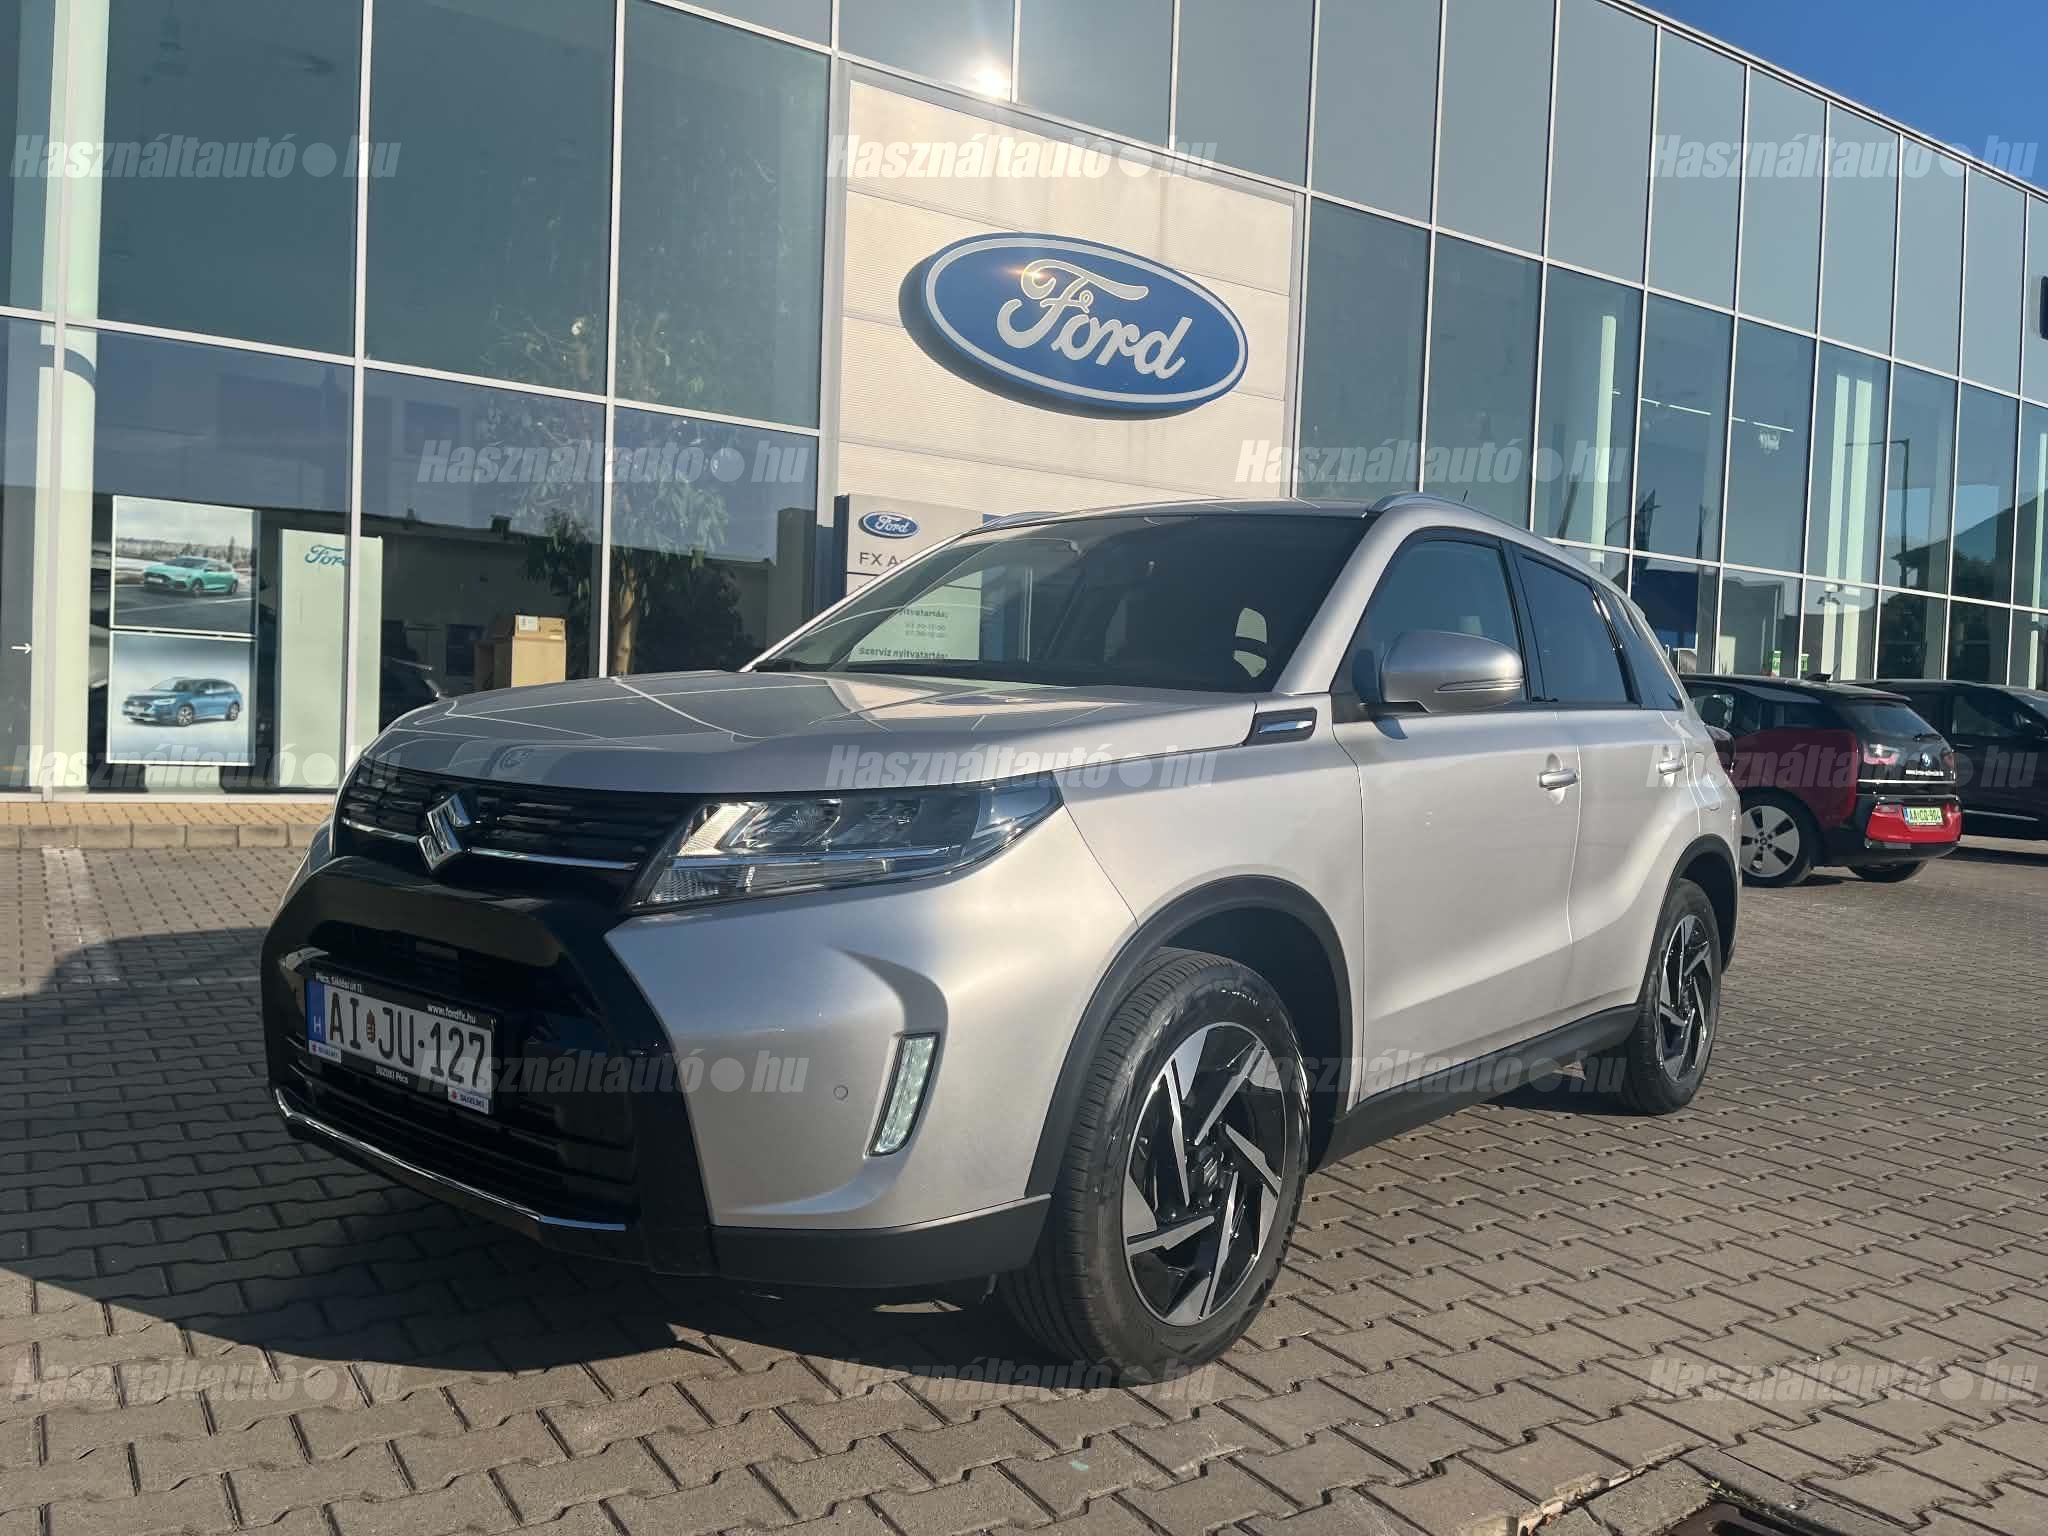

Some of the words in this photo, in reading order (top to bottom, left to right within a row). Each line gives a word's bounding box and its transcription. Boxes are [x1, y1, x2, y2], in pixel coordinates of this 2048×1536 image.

[997, 259, 1193, 379] Ford
[875, 514, 909, 533] Ford
[859, 552, 883, 566] FX
[313, 1015, 322, 1036] H
